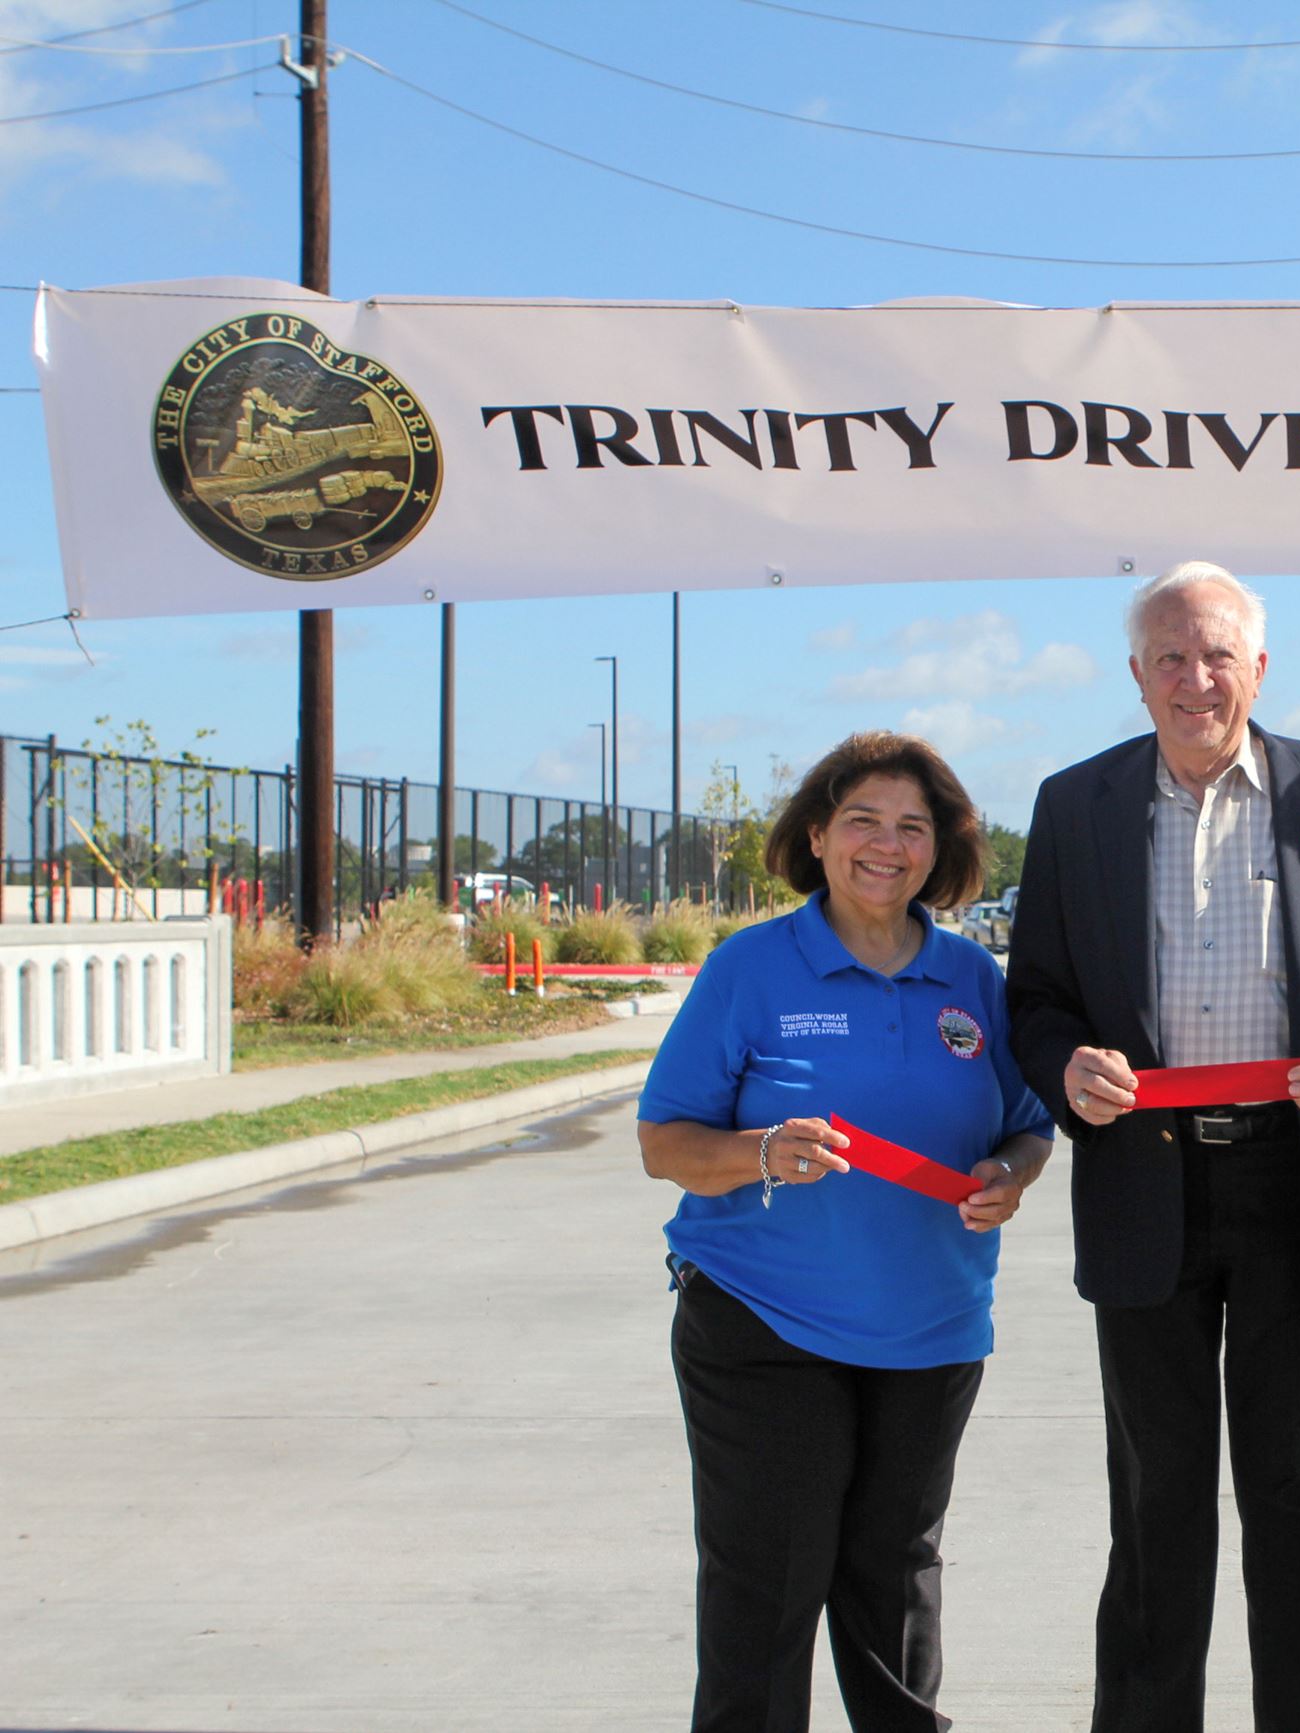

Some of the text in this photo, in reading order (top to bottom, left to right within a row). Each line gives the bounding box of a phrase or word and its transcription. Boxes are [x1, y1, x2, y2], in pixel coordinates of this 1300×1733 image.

[156, 315, 434, 455] THE CITY OF STAFFORD
[481, 401, 954, 471] TRINITY
[261, 544, 369, 573] TEXAS
[780, 1013, 848, 1023] COUNCILWOMAN
[780, 1020, 819, 1031] VIRGINIA
[781, 1030, 799, 1038] CITY
